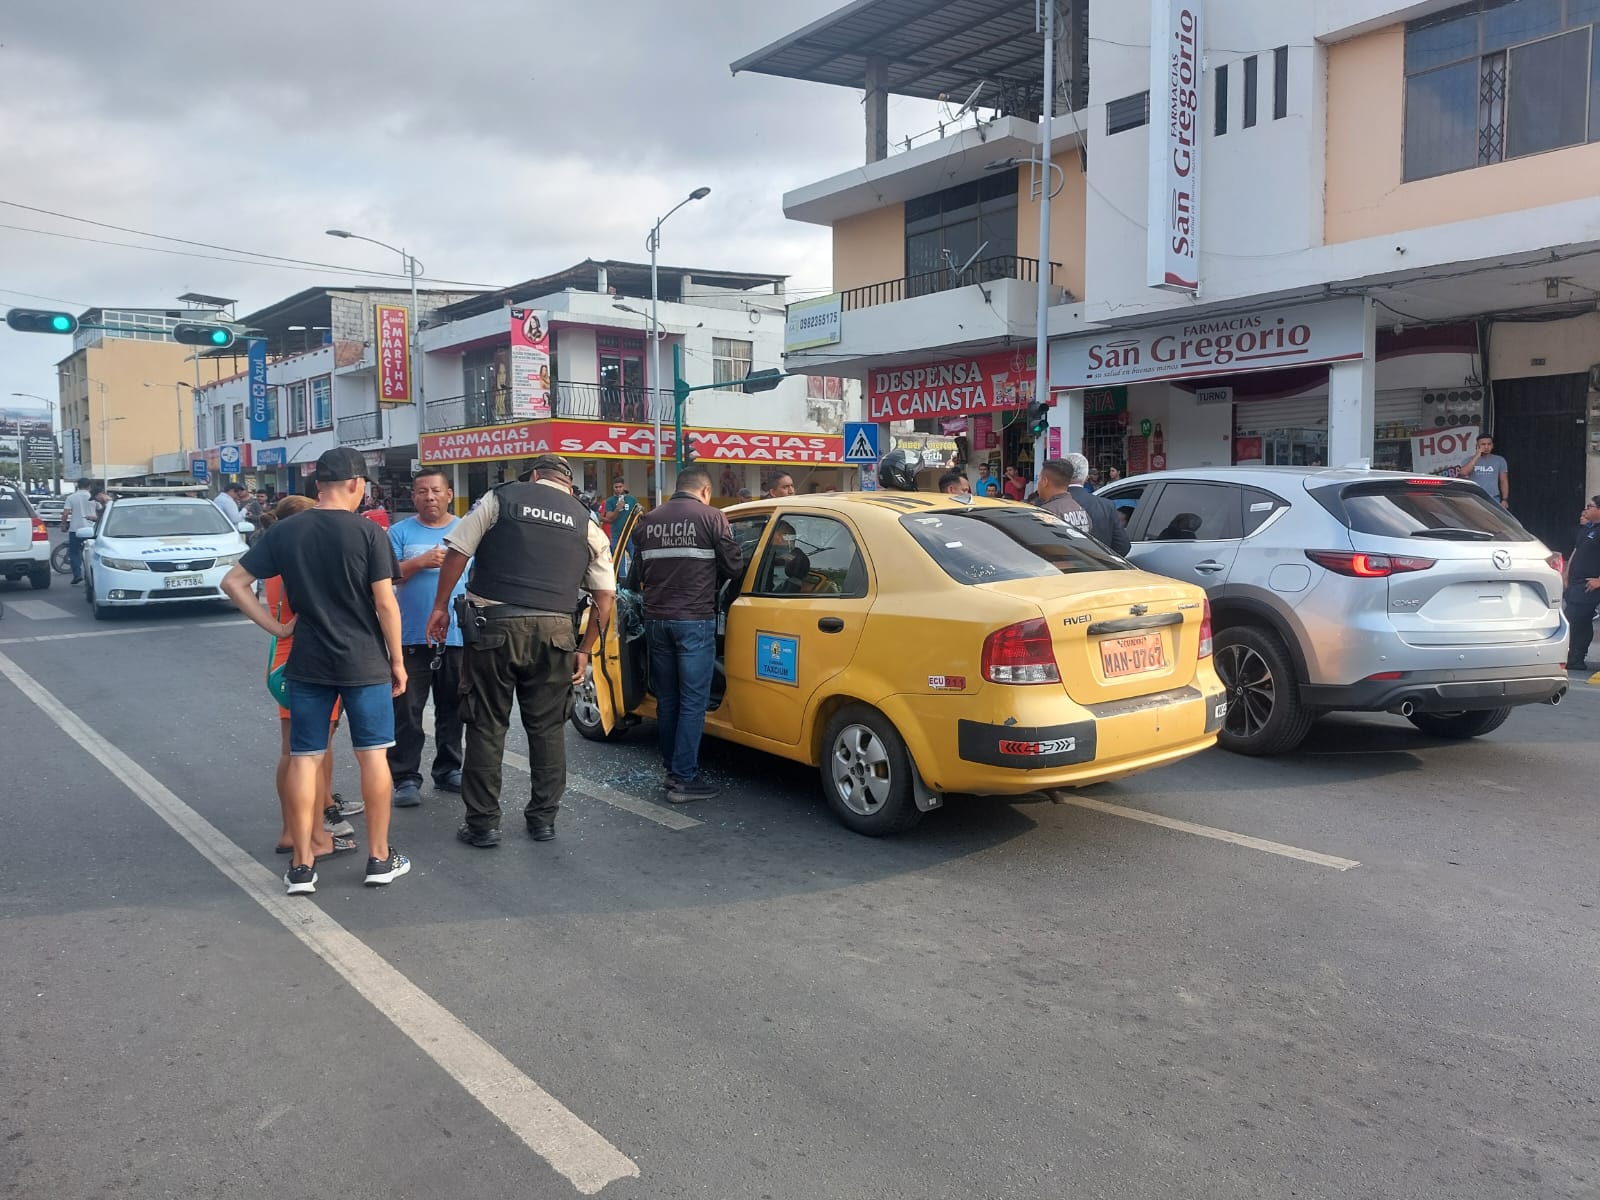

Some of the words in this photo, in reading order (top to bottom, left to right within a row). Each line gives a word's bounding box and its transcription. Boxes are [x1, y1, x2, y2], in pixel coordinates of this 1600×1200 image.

[1174, 9, 1197, 177] Gregorio
[1172, 191, 1189, 256] San
[1183, 316, 1262, 337] FARMACIAS
[382, 310, 392, 396] FARMACIAS
[1088, 344, 1140, 370] San
[1150, 317, 1311, 365] Gregorio
[392, 327, 404, 391] MARTHA
[253, 359, 264, 383] Azul
[875, 361, 983, 394] DESPENSA
[871, 396, 894, 418] LA
[897, 385, 987, 415] CANASTA
[1199, 391, 1227, 401] TURNO
[254, 397, 265, 423] Cruz
[438, 427, 529, 447] FARMACIAS
[608, 427, 826, 449] FARMACIAS
[1419, 432, 1472, 457] HOY
[424, 447, 472, 461] SANTA
[476, 439, 550, 457] MARTHA
[713, 447, 843, 462] MARTH
[522, 506, 574, 527] POLICIA
[646, 519, 697, 539] POLICÍA
[661, 536, 698, 547] NACIONAL
[1063, 614, 1092, 626] AVEO
[1104, 646, 1162, 673] MAN-0767
[929, 677, 944, 685] ECU
